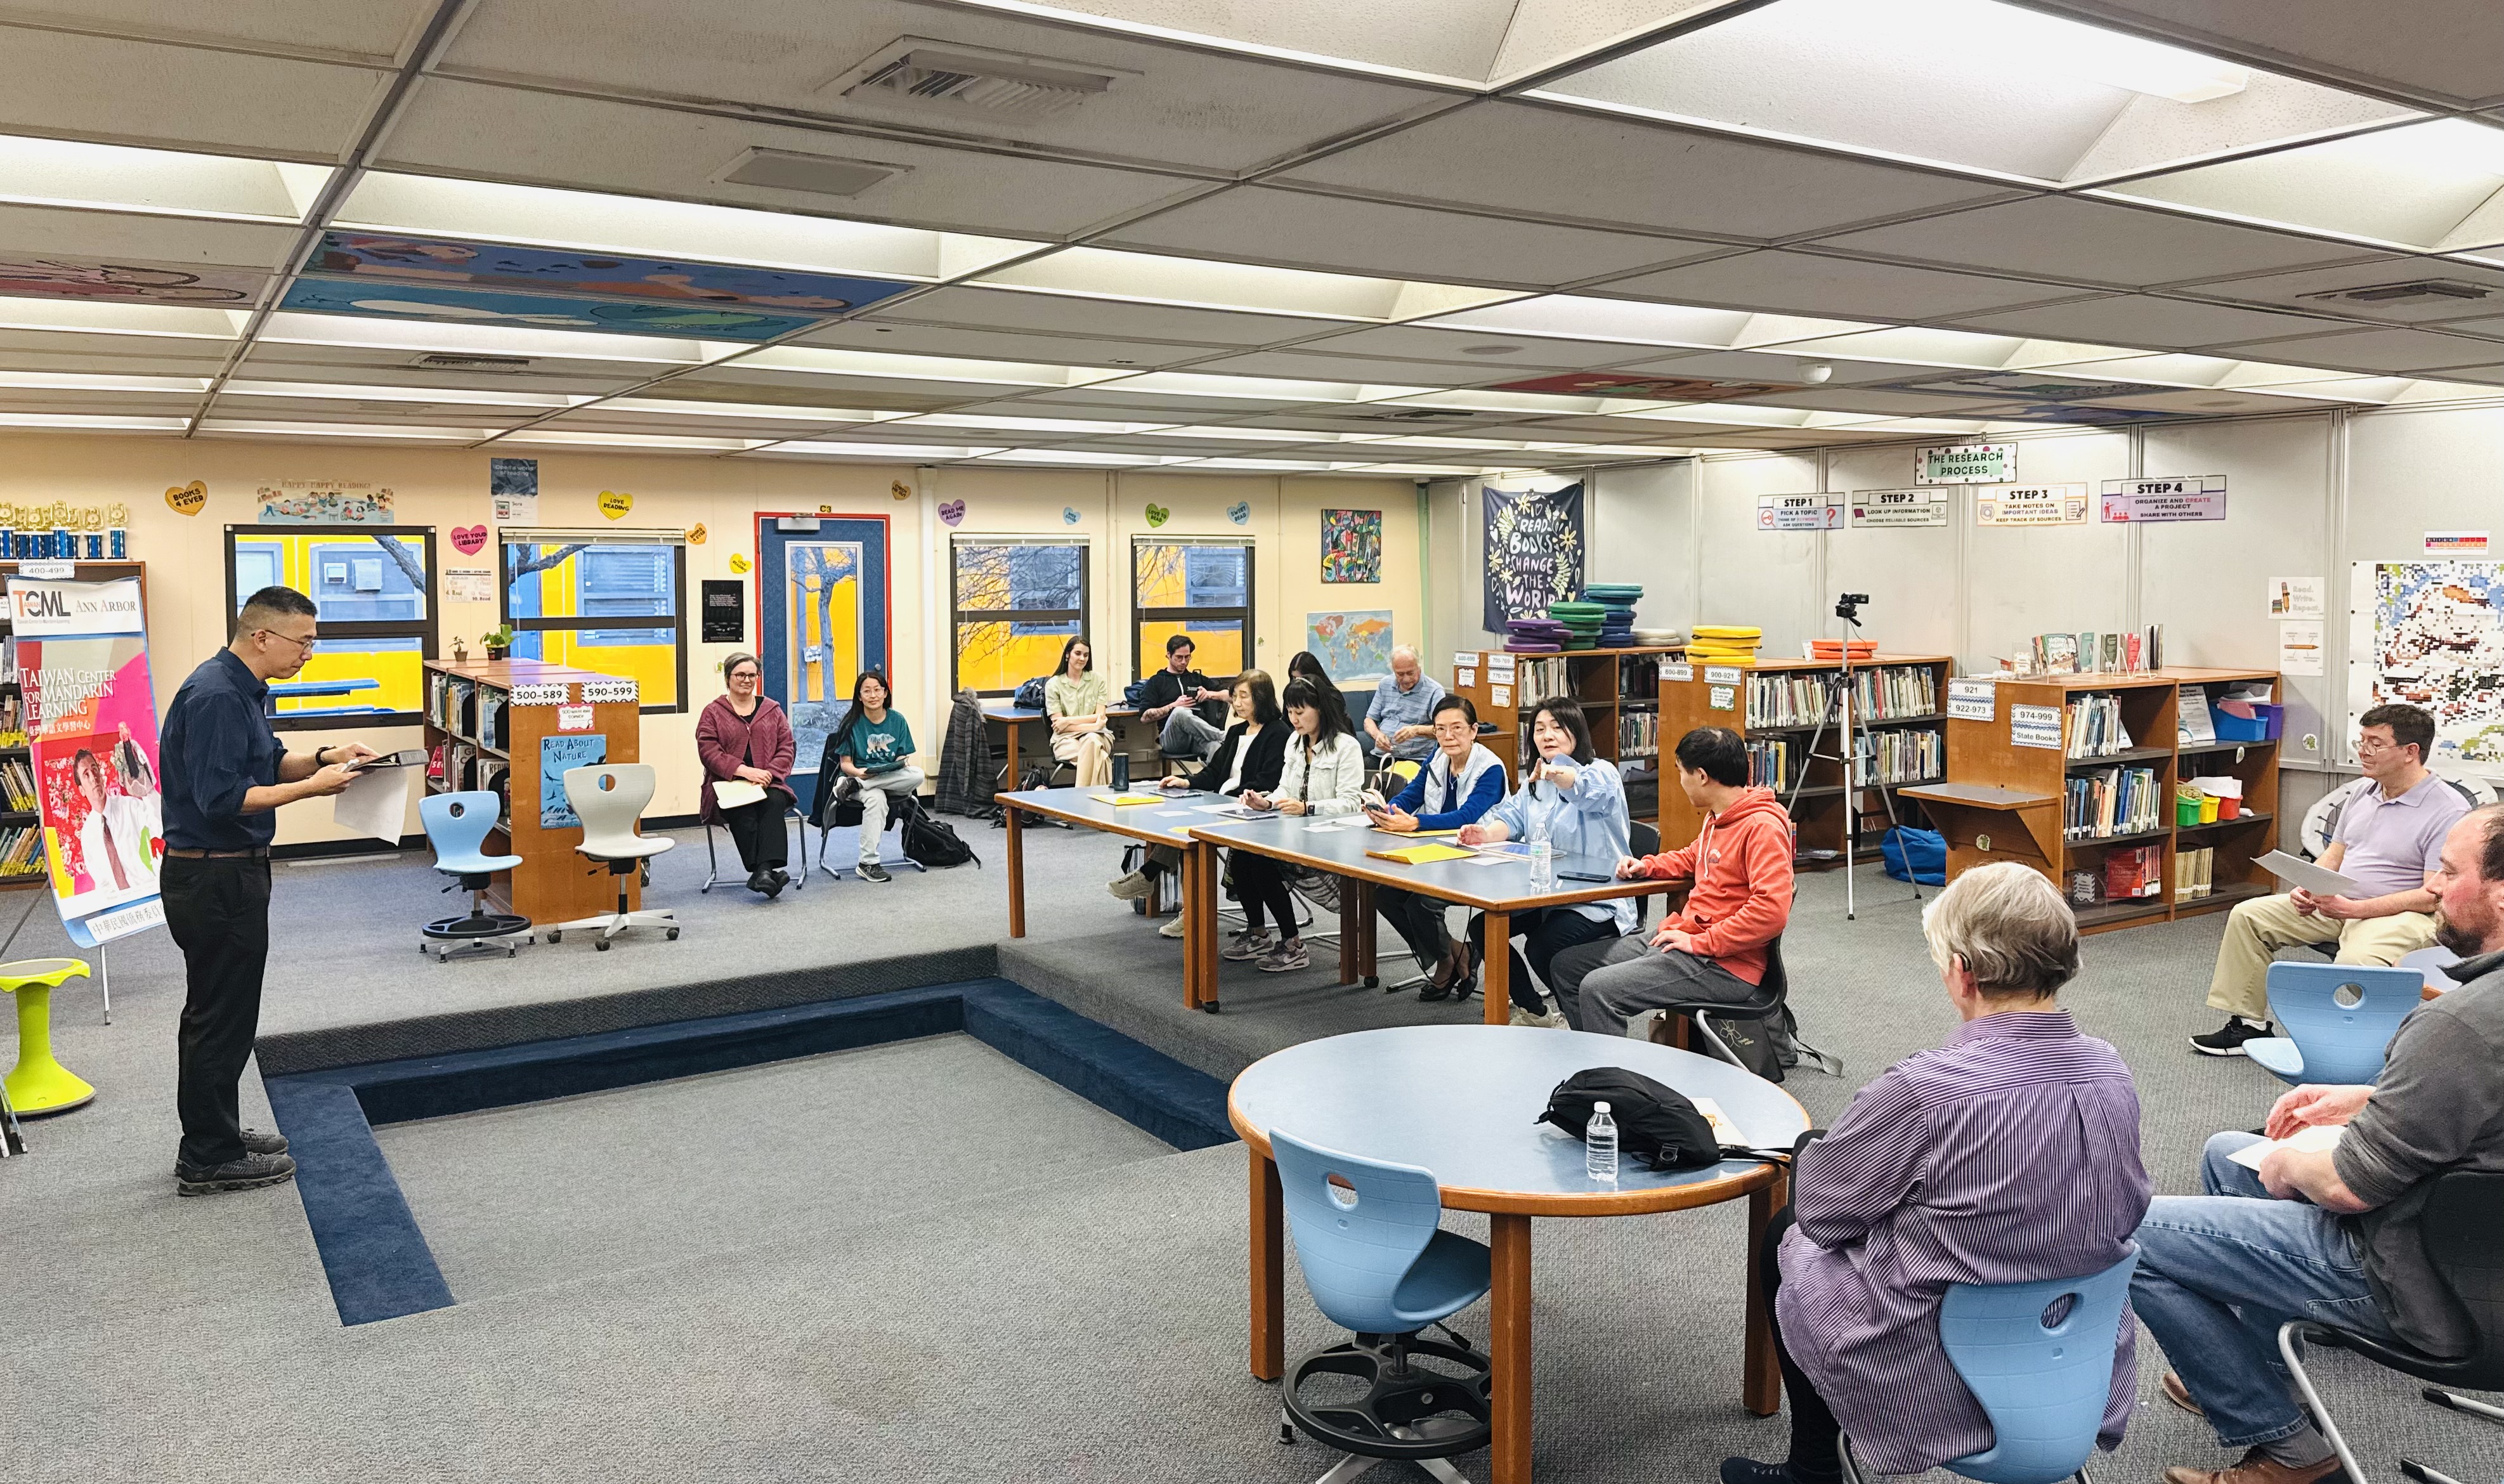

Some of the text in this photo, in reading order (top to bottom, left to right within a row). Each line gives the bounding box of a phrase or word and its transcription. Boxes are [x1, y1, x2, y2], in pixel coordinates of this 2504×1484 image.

[1928, 452, 2003, 464] THE RESEARCH
[1941, 465, 1988, 476] PROCESS
[2137, 483, 2182, 493] STEP 4
[173, 488, 201, 501] BOOKS
[1881, 494, 1914, 503] STEP 2
[2009, 490, 2048, 500] STEP 3
[184, 495, 204, 506] EVER
[1784, 498, 1813, 507] STEP 1
[603, 502, 629, 511] READING
[819, 505, 832, 513] C3
[941, 507, 955, 516] READ
[1230, 505, 1247, 517] SWEET
[946, 511, 963, 521] AGAIN
[1148, 509, 1160, 517] LOVE
[1151, 514, 1163, 523] READ
[1520, 518, 1548, 533] READ
[458, 538, 483, 546] LIBRARY
[1510, 531, 1553, 554] BOOKS
[1511, 555, 1554, 575] CHANGE
[1522, 574, 1543, 589] THE
[76, 600, 98, 613] ANN
[101, 599, 136, 612] ARBOR
[2293, 604, 2320, 613] Repeat.
[20, 668, 116, 688] TAIWAN CENTER
[24, 682, 114, 705] FOR MANDARIN
[517, 691, 562, 700] 500-589
[588, 687, 632, 696] 590-599
[26, 700, 88, 720] LEARNING
[1955, 705, 1986, 713] 922-973
[2020, 711, 2052, 720] 974-999
[2035, 734, 2056, 742] Books
[544, 738, 594, 751] READ ABOUT
[553, 750, 587, 763] NATURE
